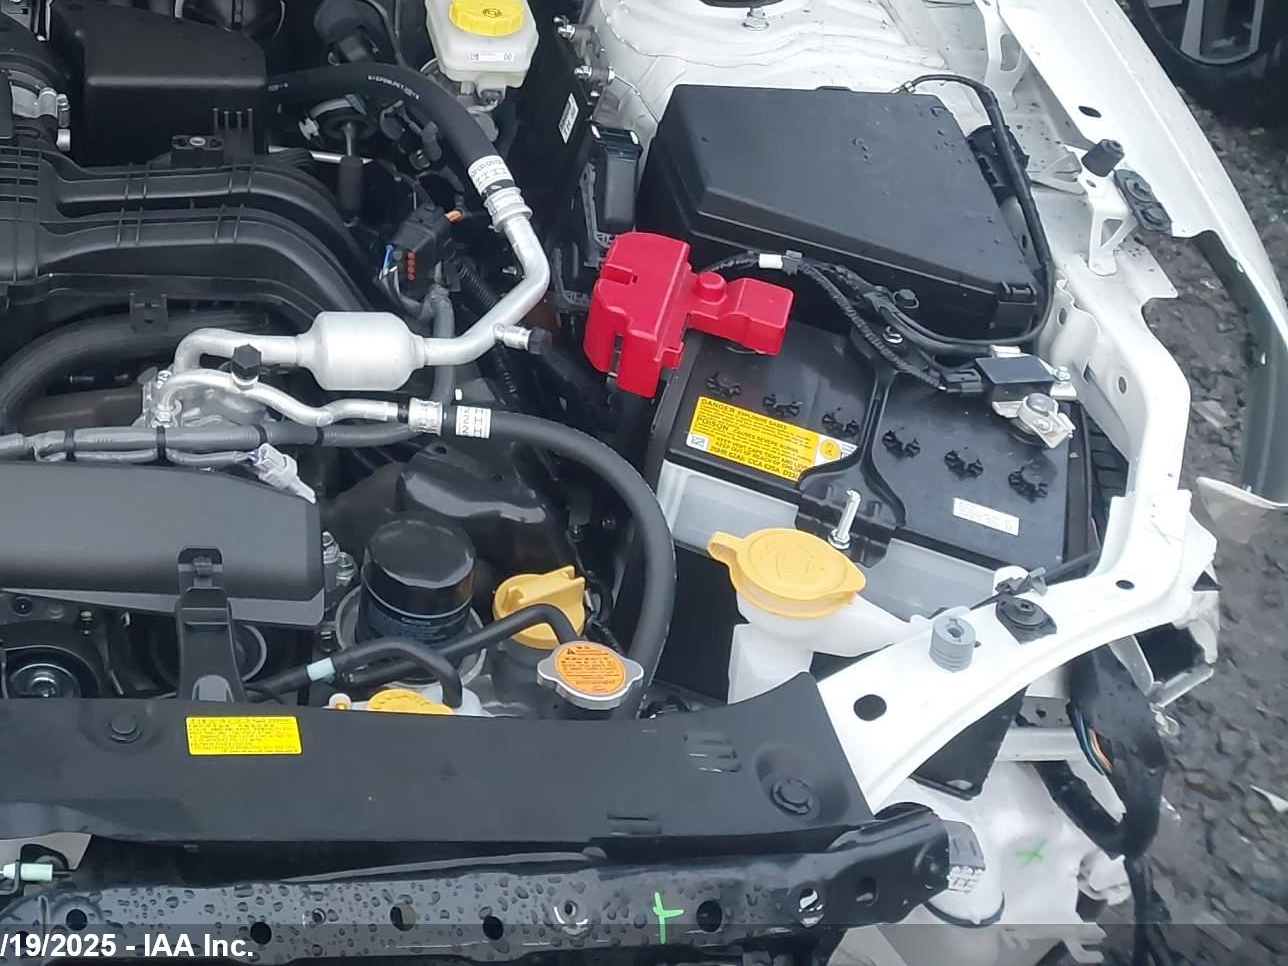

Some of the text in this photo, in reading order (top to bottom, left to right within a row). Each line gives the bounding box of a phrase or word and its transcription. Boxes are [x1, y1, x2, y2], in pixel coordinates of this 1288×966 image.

[701, 399, 735, 413] DANGER
[696, 417, 729, 431] POISON
[733, 429, 756, 439] CAUSES
[757, 436, 778, 446] SEVERE
[748, 458, 763, 467] CCA
